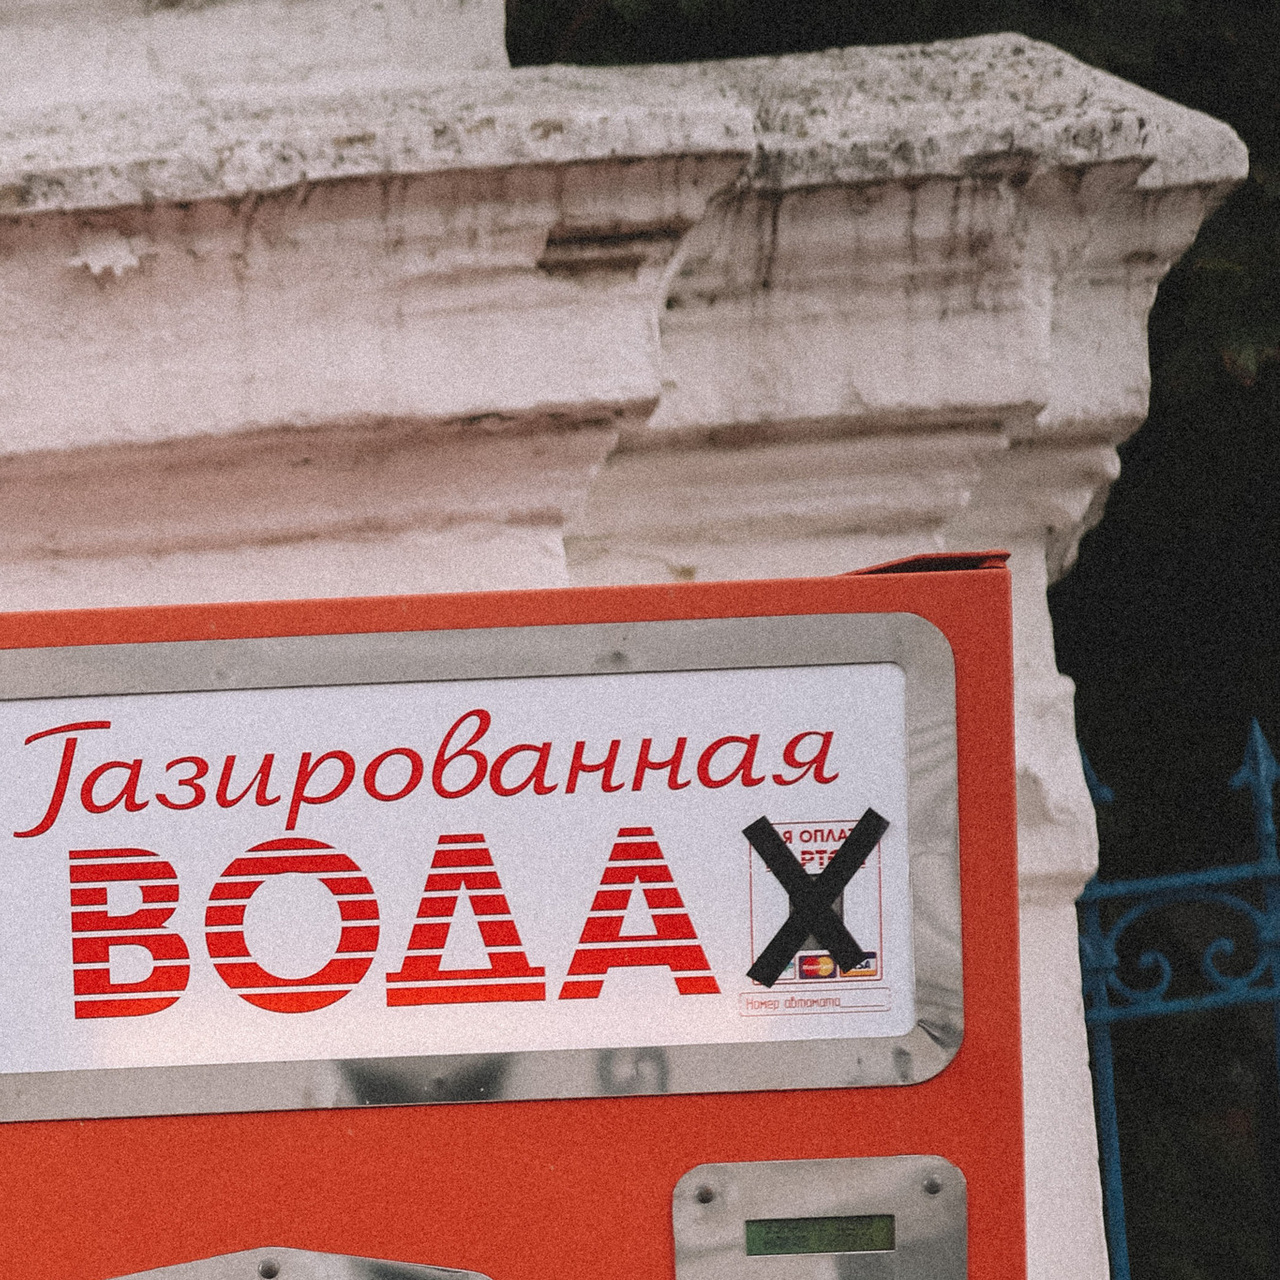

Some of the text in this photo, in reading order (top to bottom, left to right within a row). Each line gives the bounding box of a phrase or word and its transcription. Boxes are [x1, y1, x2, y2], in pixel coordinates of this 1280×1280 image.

[14, 709, 839, 838] Газированная
[69, 827, 722, 1018] ВОДА
[746, 998, 779, 1010] Номер
